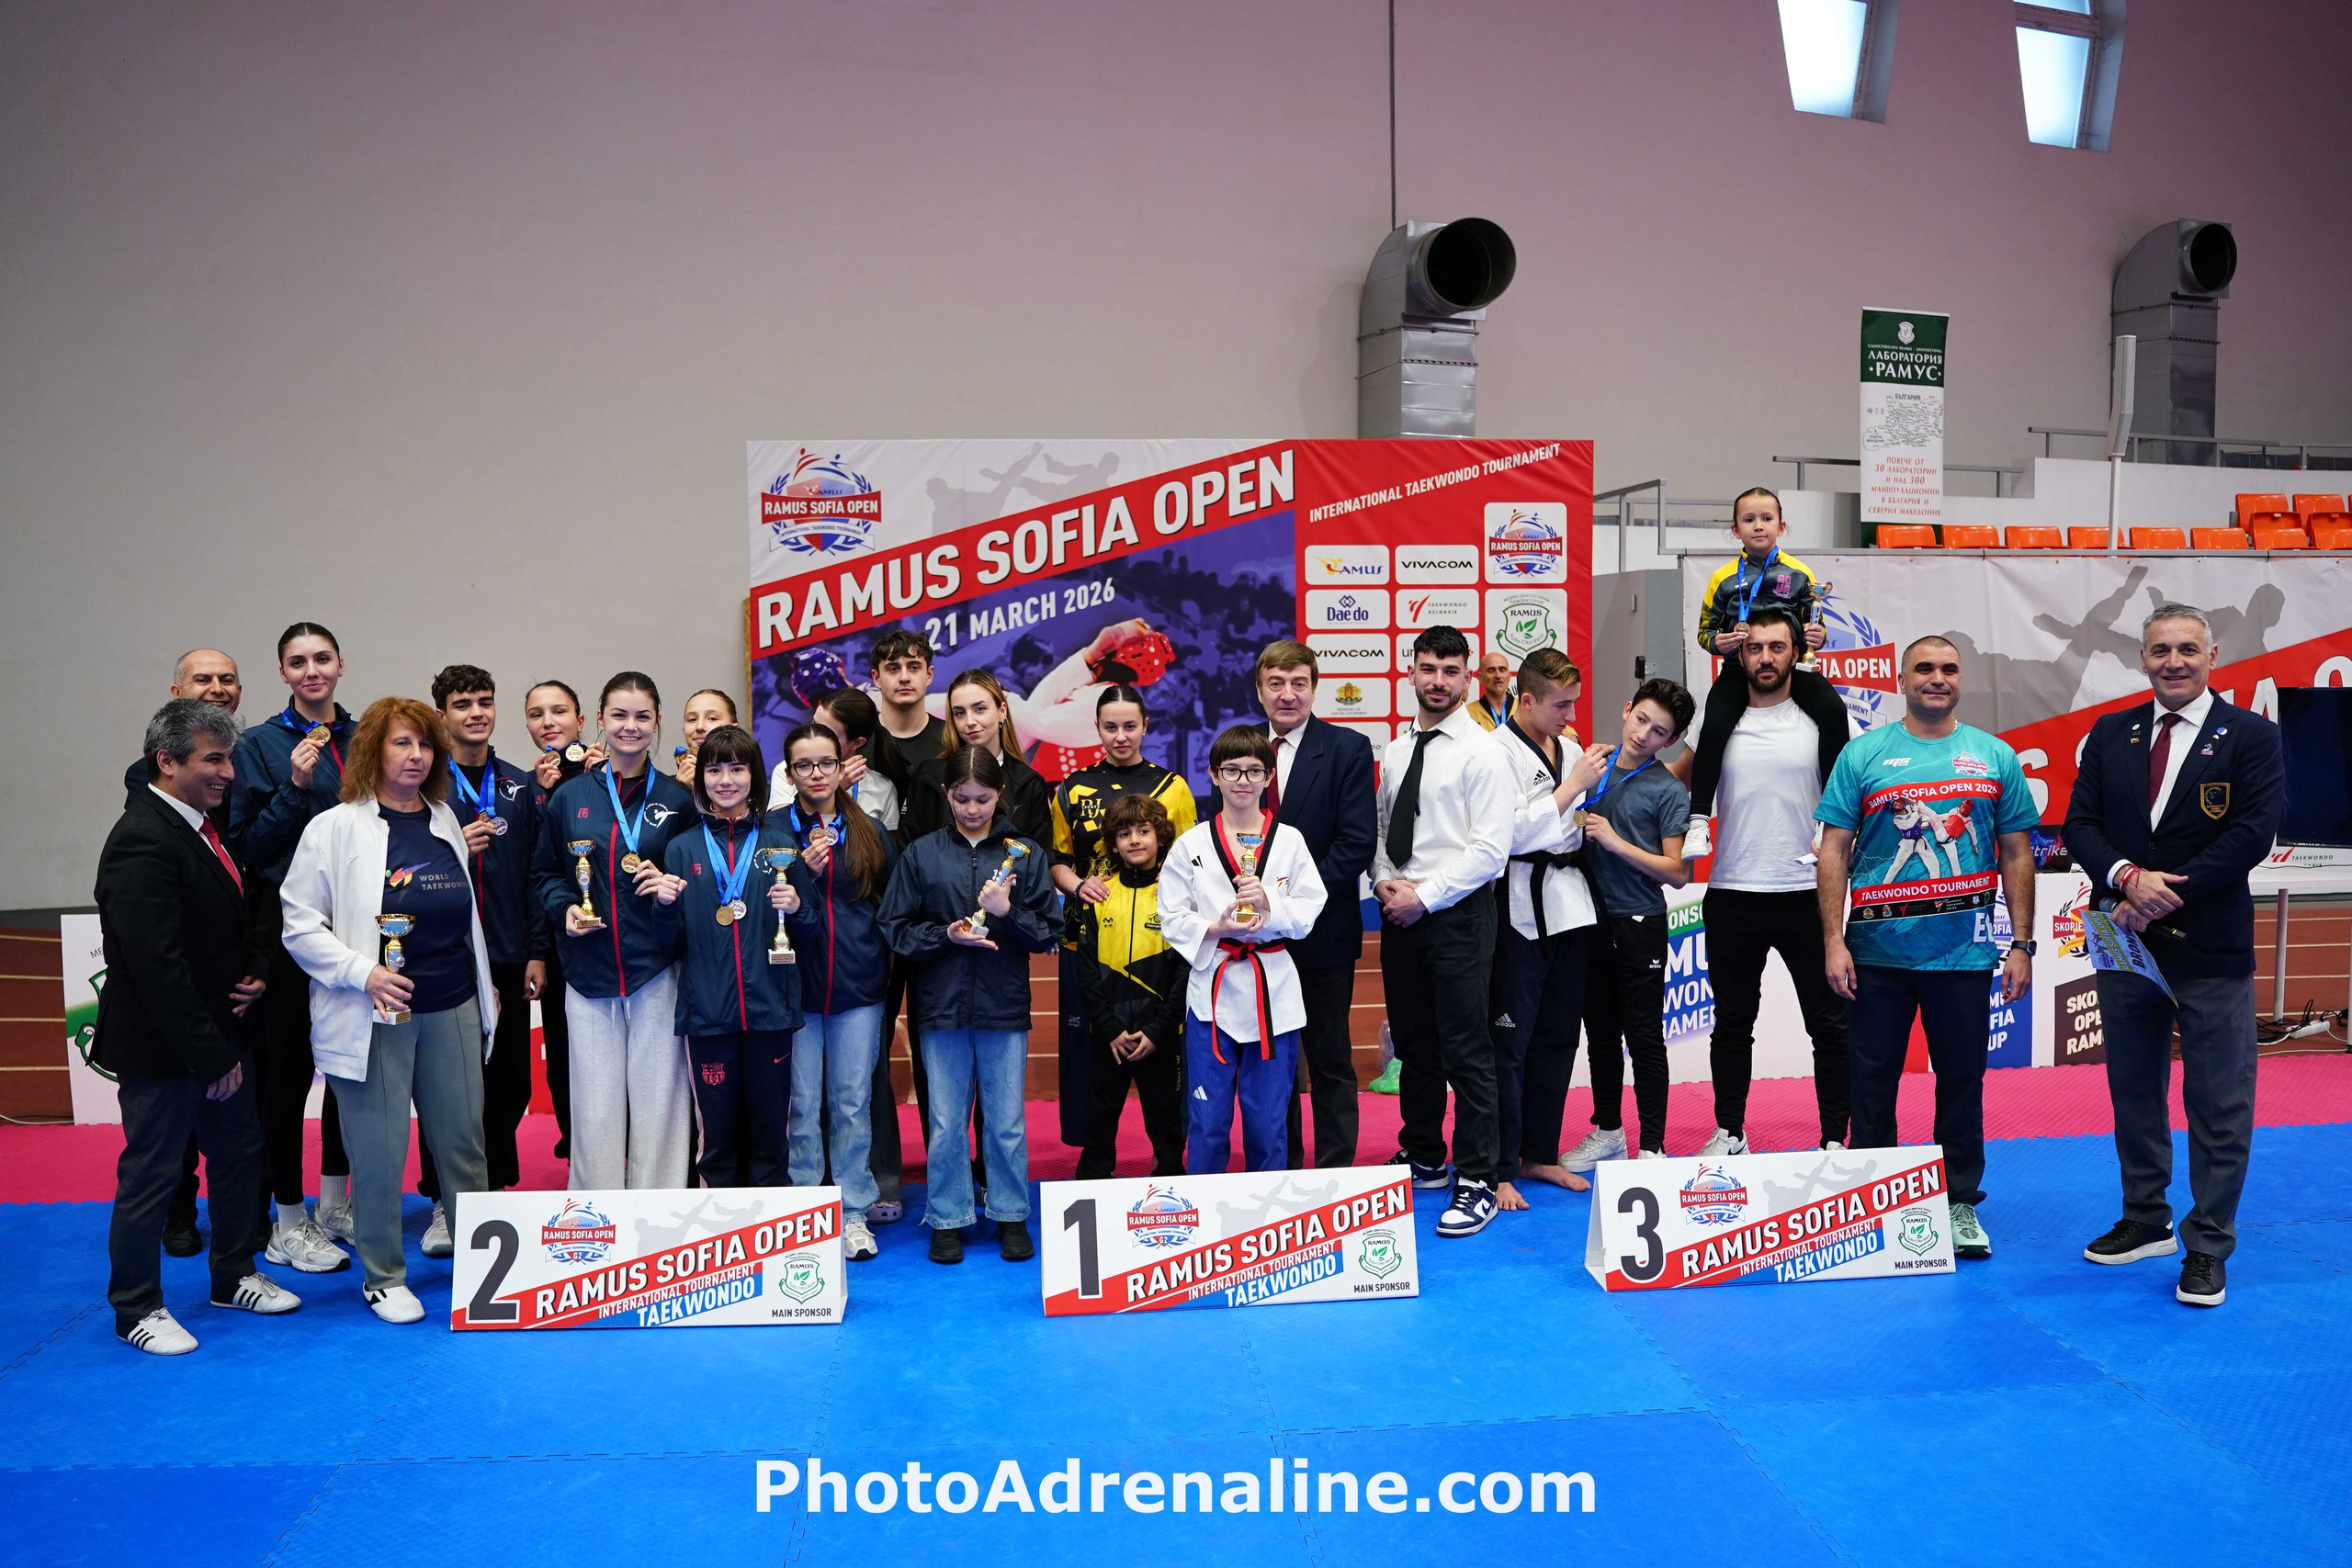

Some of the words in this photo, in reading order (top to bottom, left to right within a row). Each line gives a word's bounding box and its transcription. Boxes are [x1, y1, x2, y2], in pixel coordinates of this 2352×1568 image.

[1868, 350, 1942, 365] ЛАБОРАТОРИЯ
[1886, 457, 1912, 465] ПОВЕЧЕ
[1874, 464, 1885, 472] 30
[1887, 466, 1937, 475] ЛАБОРАТОРИИ
[1309, 485, 1403, 523] INTERNATIONAL
[1405, 465, 1480, 497] TAEKWONDO
[1482, 443, 1561, 476] TOURNAMENT
[1909, 476, 1926, 484] 300
[1870, 486, 1939, 495] МАНИПУЛАЦИОННИ
[764, 502, 808, 515] RAMUS
[809, 501, 844, 514] SOFIA
[847, 500, 878, 513] OPEN
[1887, 496, 1921, 505] БЪЛГАРИЯ
[1868, 506, 1897, 514] СЕВЕРНА
[1900, 508, 1941, 516] МАКЕДОНИЯ
[757, 543, 961, 649] RAMUS
[976, 496, 1139, 585] SOFIA
[1152, 448, 1295, 535] OPEN
[1491, 542, 1518, 551] RAMUS
[1519, 541, 1541, 551] SOFIA
[1542, 541, 1561, 550] OPEN
[1401, 560, 1473, 569] VIVACOM
[924, 616, 957, 650] 21
[969, 593, 1056, 637] MARCH
[1063, 577, 1115, 614] 2026
[1510, 609, 1543, 617] RAMUS
[1314, 649, 1385, 658] VIVACOM
[1844, 658, 1892, 679] OPEN
[1902, 787, 1938, 798] SOFIA
[1939, 783, 1973, 795] OPEN
[1974, 783, 1997, 795] 2026
[419, 874, 449, 882] WORLD
[422, 881, 467, 891] TAEKWOND
[1861, 885, 1929, 901] TAEKWONDO
[2054, 921, 2084, 932] SKOPJE
[2127, 936, 2145, 969] BRON
[1682, 1194, 1706, 1203] RAMUS
[1707, 1193, 1727, 1201] SOFIA
[1728, 1192, 1746, 1201] OPEN
[1129, 1216, 1155, 1225] RAMUS
[1156, 1215, 1177, 1224] SOFIA
[1178, 1213, 1197, 1223] OPEN
[1681, 1223, 1789, 1279] RAMUS
[1793, 1194, 1867, 1238] SOFIA
[1872, 1166, 1939, 1211] OPEN
[544, 1231, 570, 1240] RAMUS
[571, 1231, 593, 1239] SOFIA
[594, 1230, 614, 1238] OPEN
[1617, 1187, 1666, 1280] 3
[1063, 1199, 1100, 1296] 1
[1126, 1246, 1233, 1303] RAMUS
[1240, 1214, 1327, 1263] SOFIA
[1332, 1184, 1407, 1233] OPEN
[1739, 1244, 1813, 1277] INTERNATIONAL
[1813, 1220, 1876, 1251] TOURNAMENT
[535, 1261, 649, 1321] RAMUS
[656, 1234, 748, 1282] SOFIA
[753, 1207, 834, 1255] OPEN
[1774, 1232, 1878, 1283] TAEKWONDO
[1894, 1260, 1913, 1269] MAIN
[1915, 1258, 1948, 1269] SPONSOR
[469, 1220, 520, 1321] 2
[1187, 1268, 1267, 1301] INTERNATIONAL
[1268, 1242, 1336, 1274] TOURNAMENT
[1226, 1255, 1337, 1307] TAEKWONDO
[1353, 1284, 1374, 1293] MAIN
[1375, 1281, 1410, 1292] SPONSOR
[597, 1287, 681, 1319] INTERNATIONAL
[682, 1264, 755, 1297] TOURNAMENT
[637, 1278, 755, 1326] TAEKWONDO
[772, 1309, 793, 1317] MAIN
[795, 1308, 831, 1317] SPONSOR
